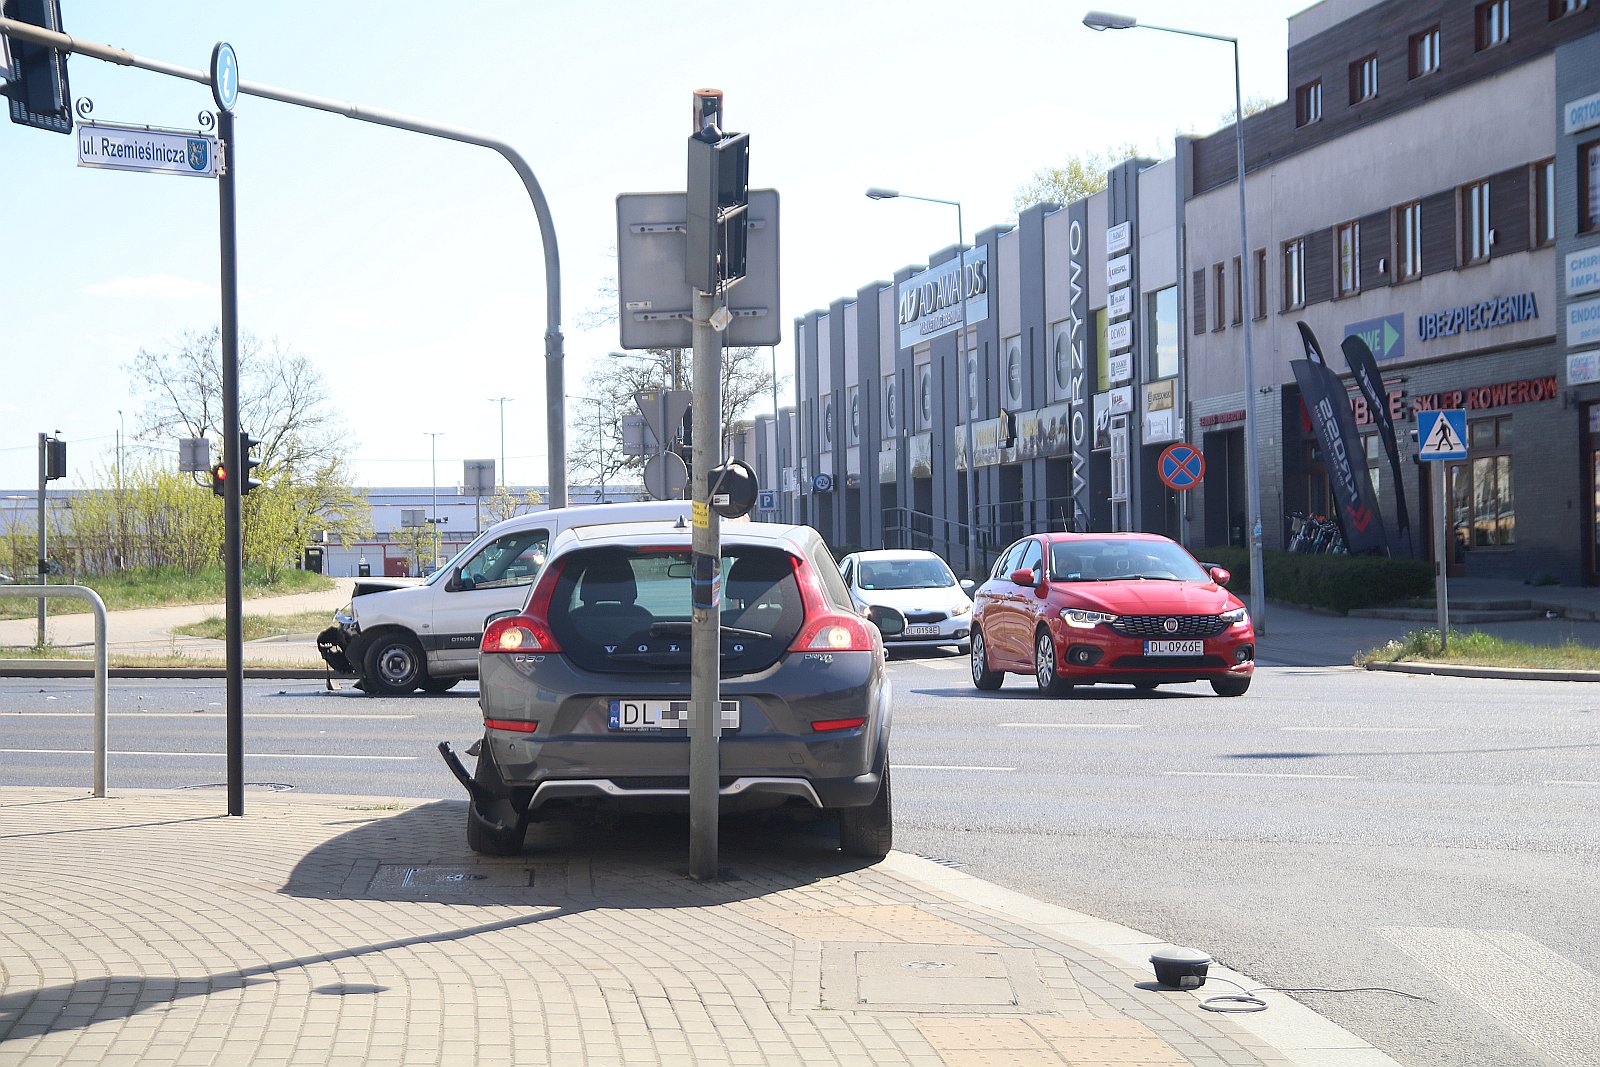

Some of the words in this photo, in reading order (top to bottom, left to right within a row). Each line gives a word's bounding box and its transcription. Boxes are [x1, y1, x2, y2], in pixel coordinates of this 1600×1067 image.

[82, 136, 98, 155] ul.
[101, 137, 186, 164] Rzemieślnicza
[1570, 256, 1600, 271] CHIR
[1570, 272, 1600, 288] IMPL
[1418, 292, 1539, 342] UBEZPIECZENIA
[1412, 389, 1463, 417] SKLEP
[1467, 375, 1558, 410] ROWEROW
[603, 644, 744, 653] VOLO
[1151, 641, 1165, 653] DL
[1168, 641, 1201, 653] 0966E
[624, 703, 655, 725] DL
